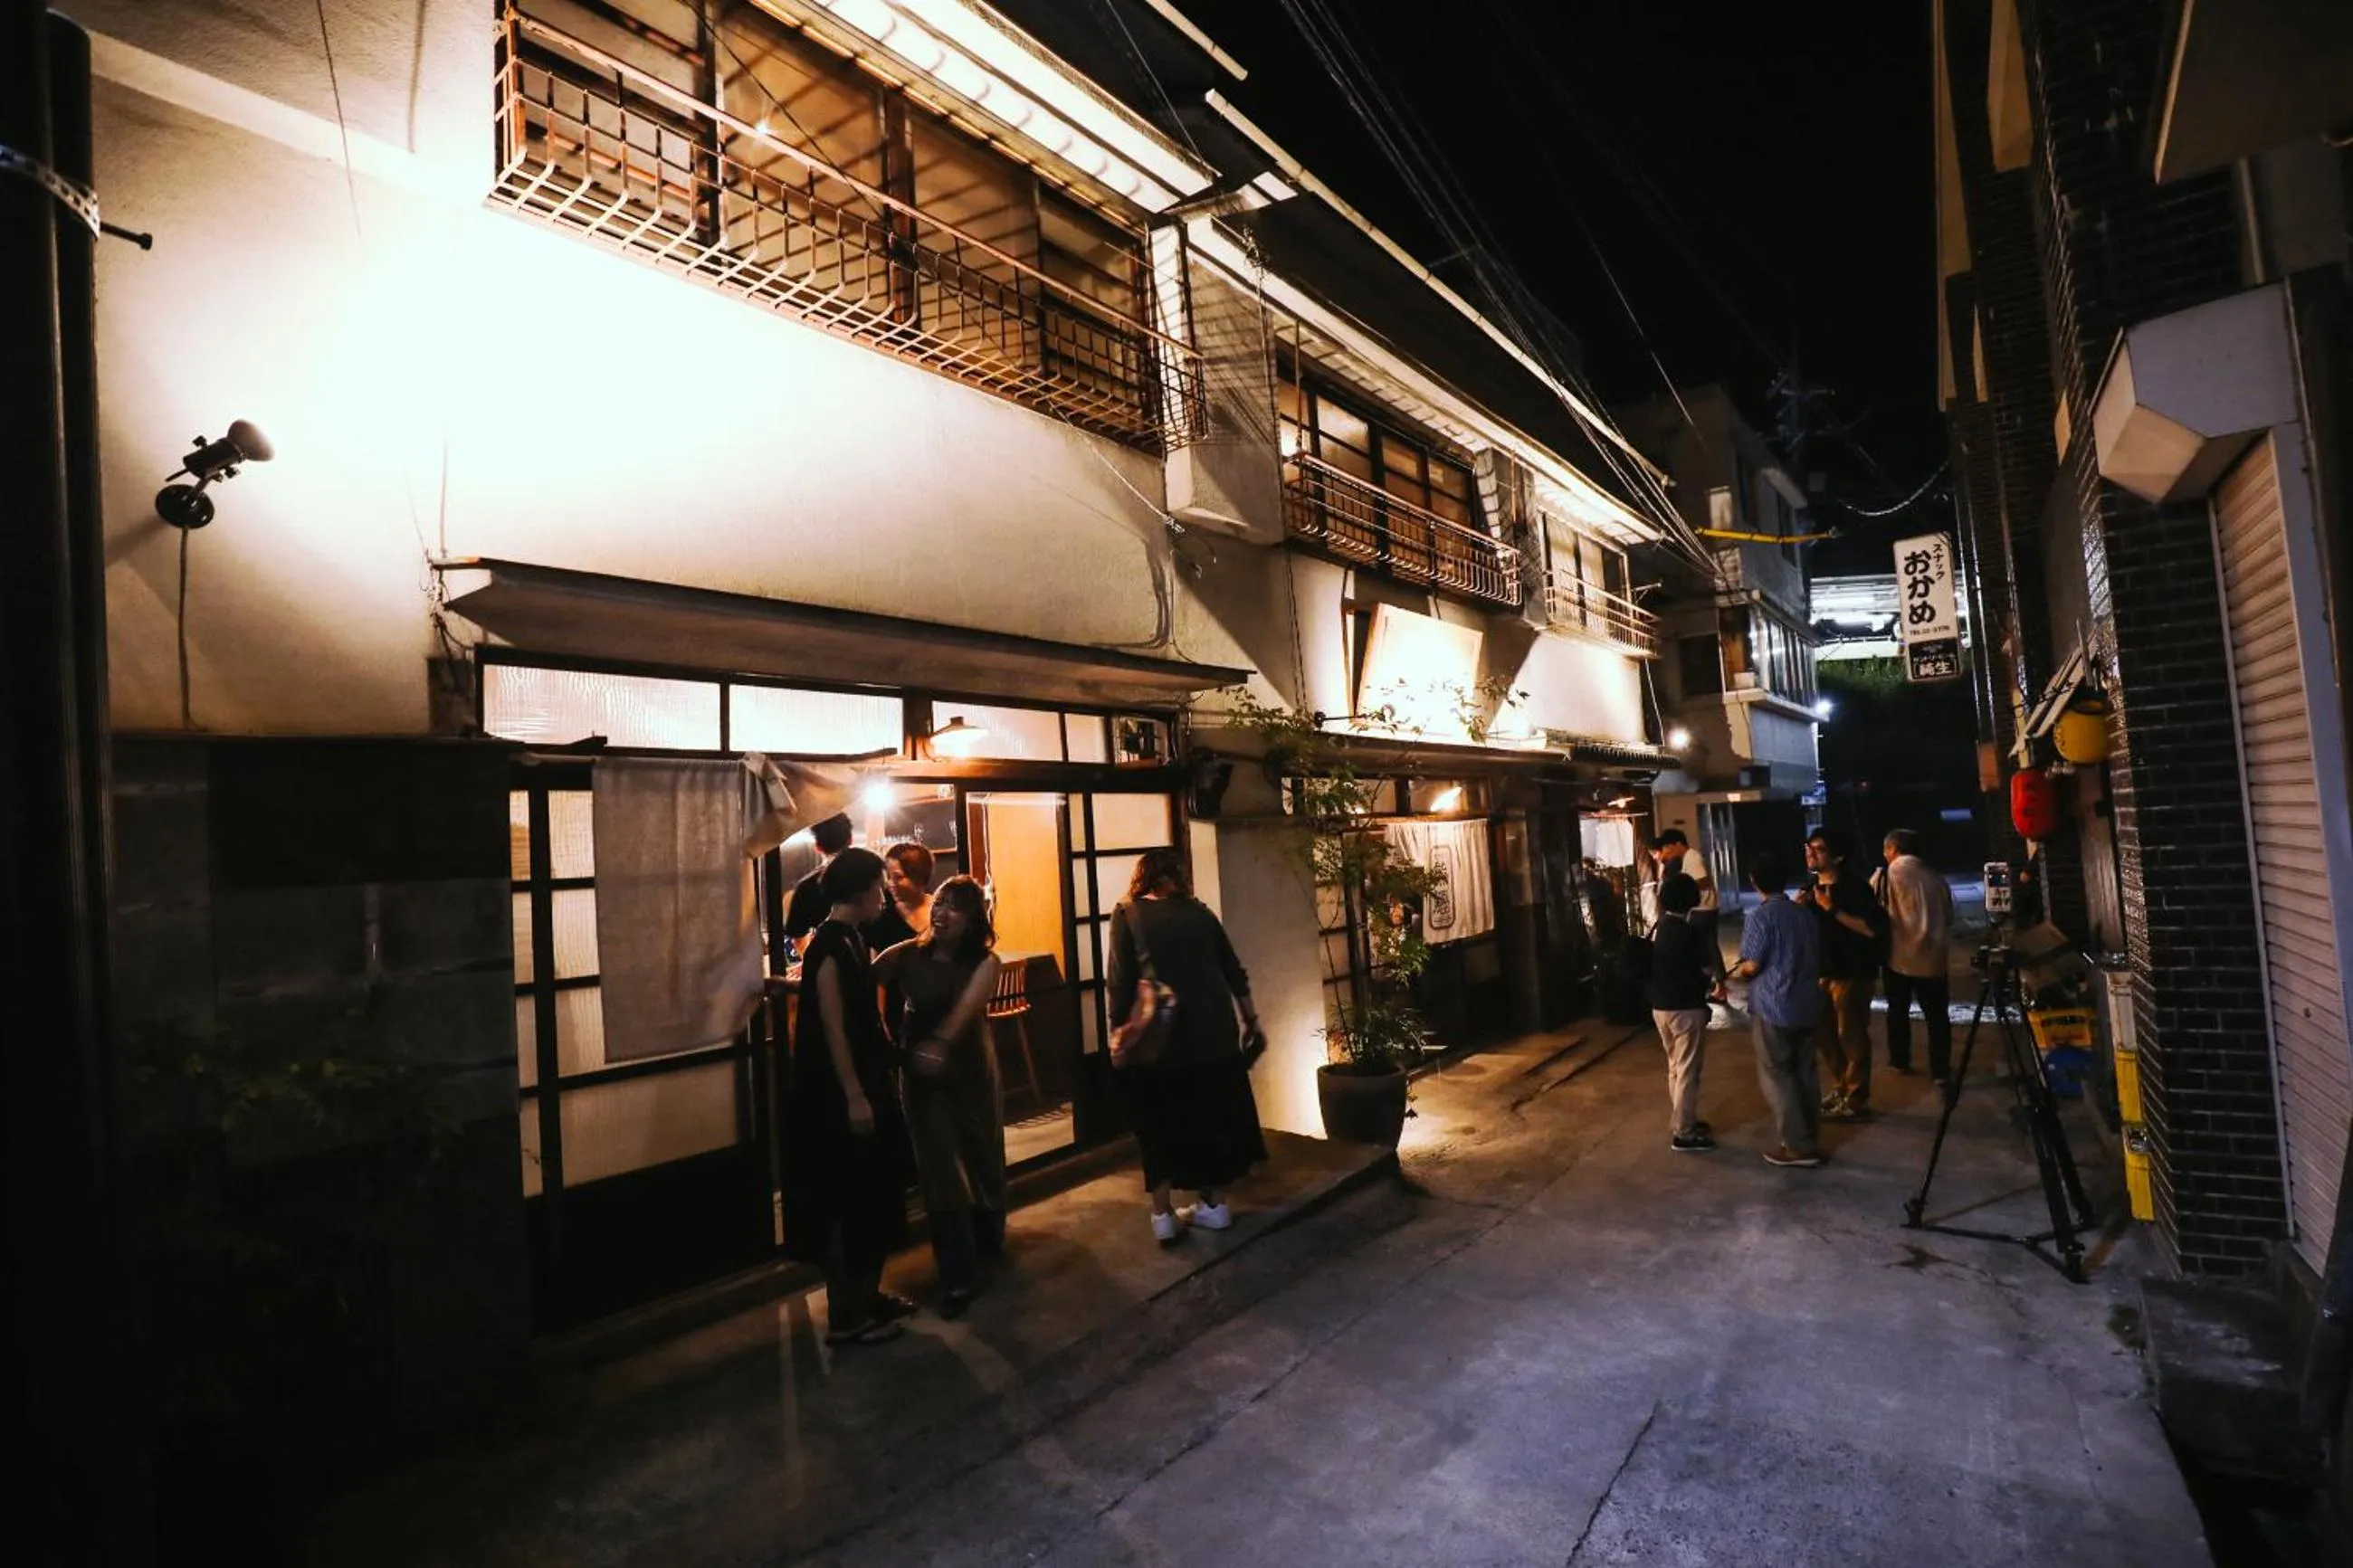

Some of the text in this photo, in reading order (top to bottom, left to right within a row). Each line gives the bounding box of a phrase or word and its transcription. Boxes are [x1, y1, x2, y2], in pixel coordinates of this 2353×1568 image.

[1904, 549, 1936, 624] おかめ
[1933, 543, 1946, 581] スナック
